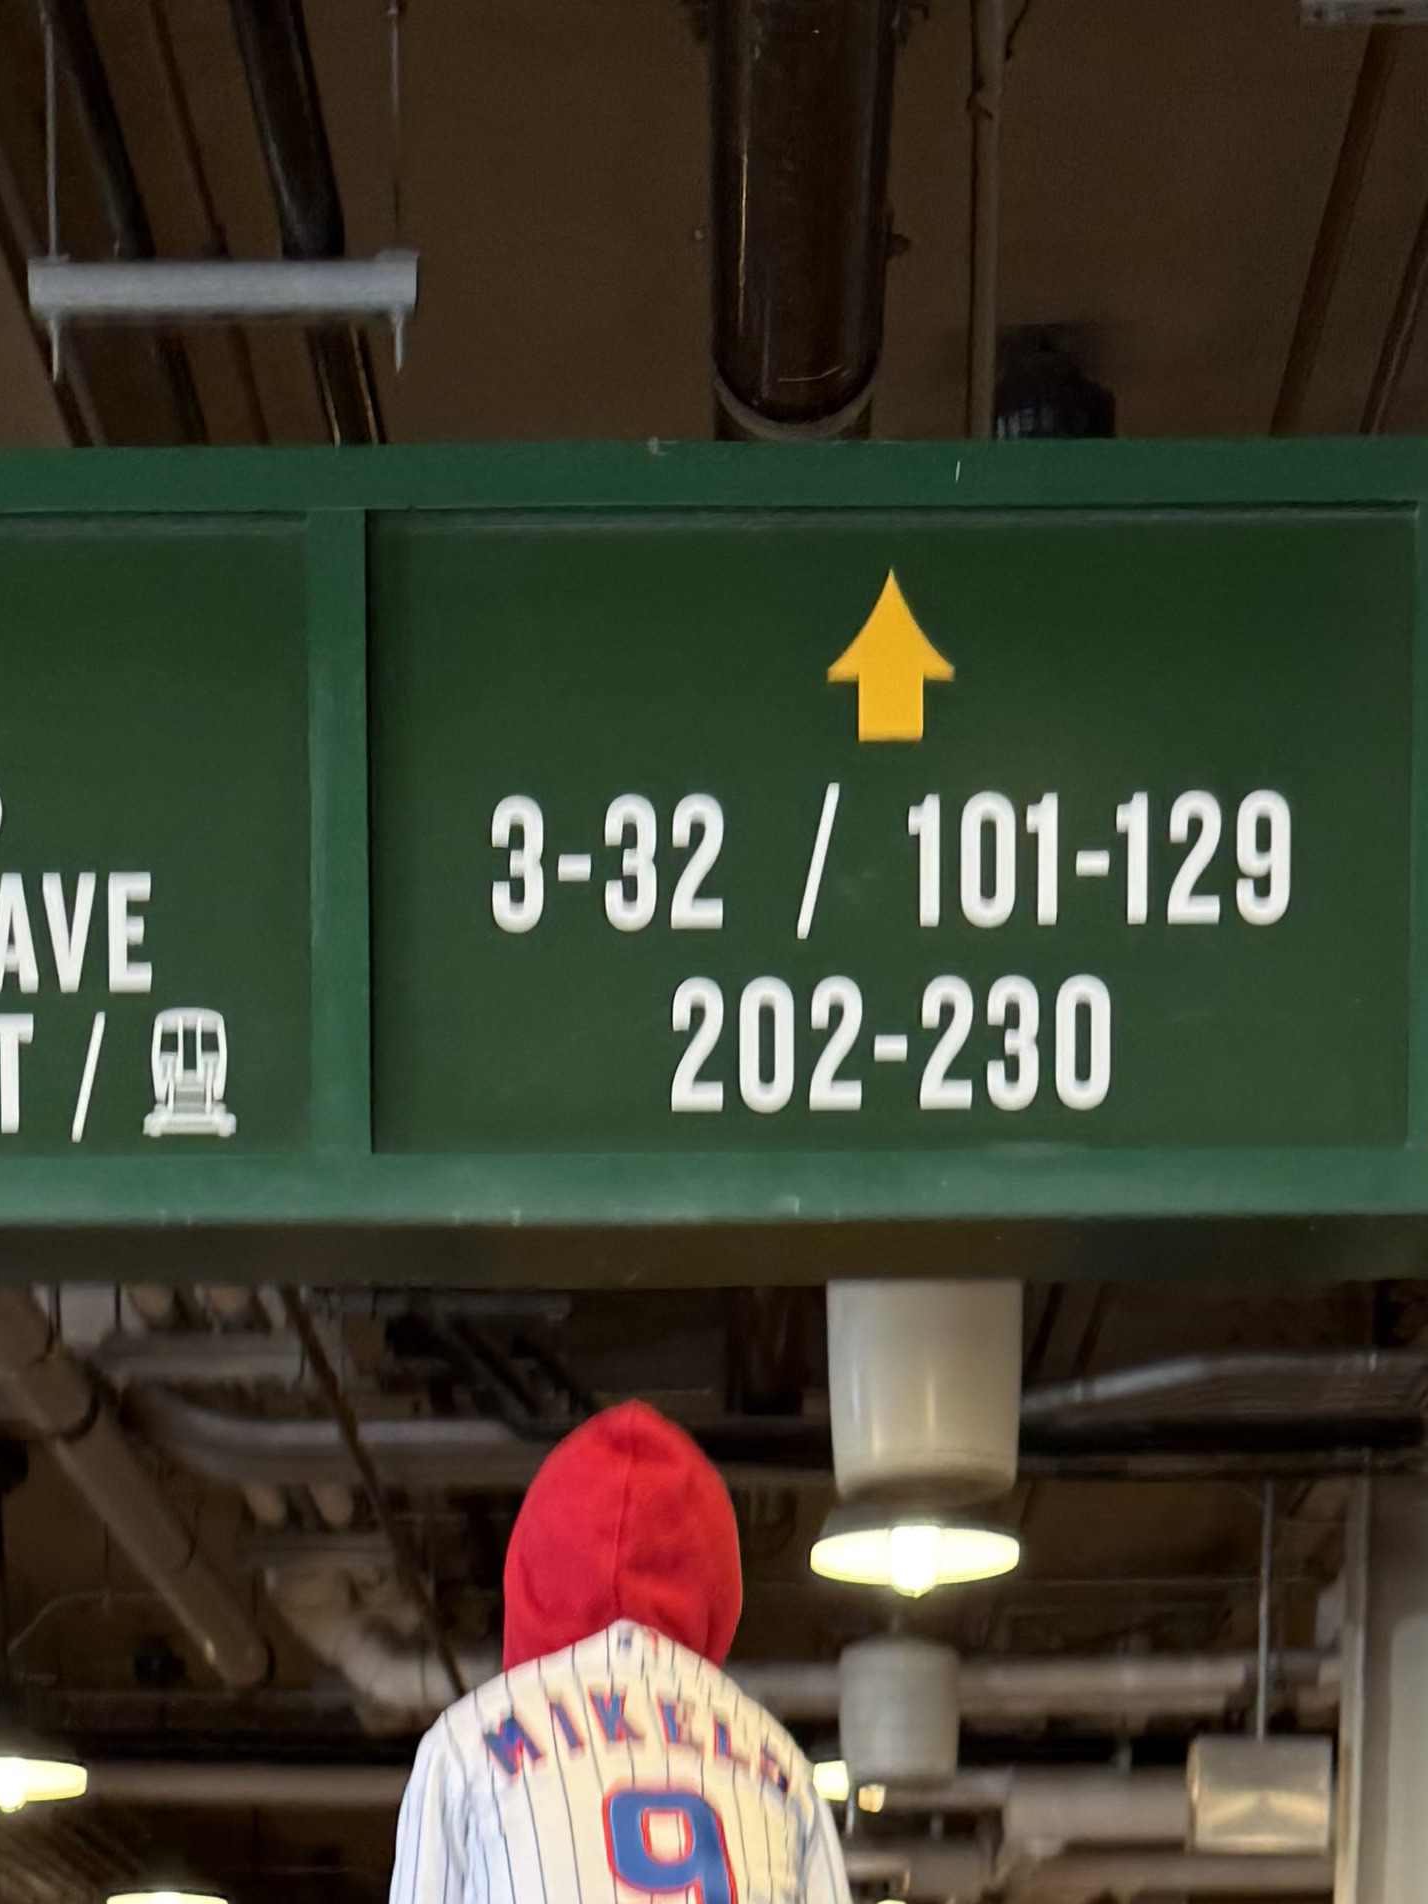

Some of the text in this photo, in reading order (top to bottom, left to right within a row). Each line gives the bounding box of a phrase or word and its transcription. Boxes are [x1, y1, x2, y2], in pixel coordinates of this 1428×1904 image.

[490, 782, 1292, 940] 3-32 / 101-129
[71, 1011, 107, 1143] /
[670, 974, 1112, 1113] 202-230
